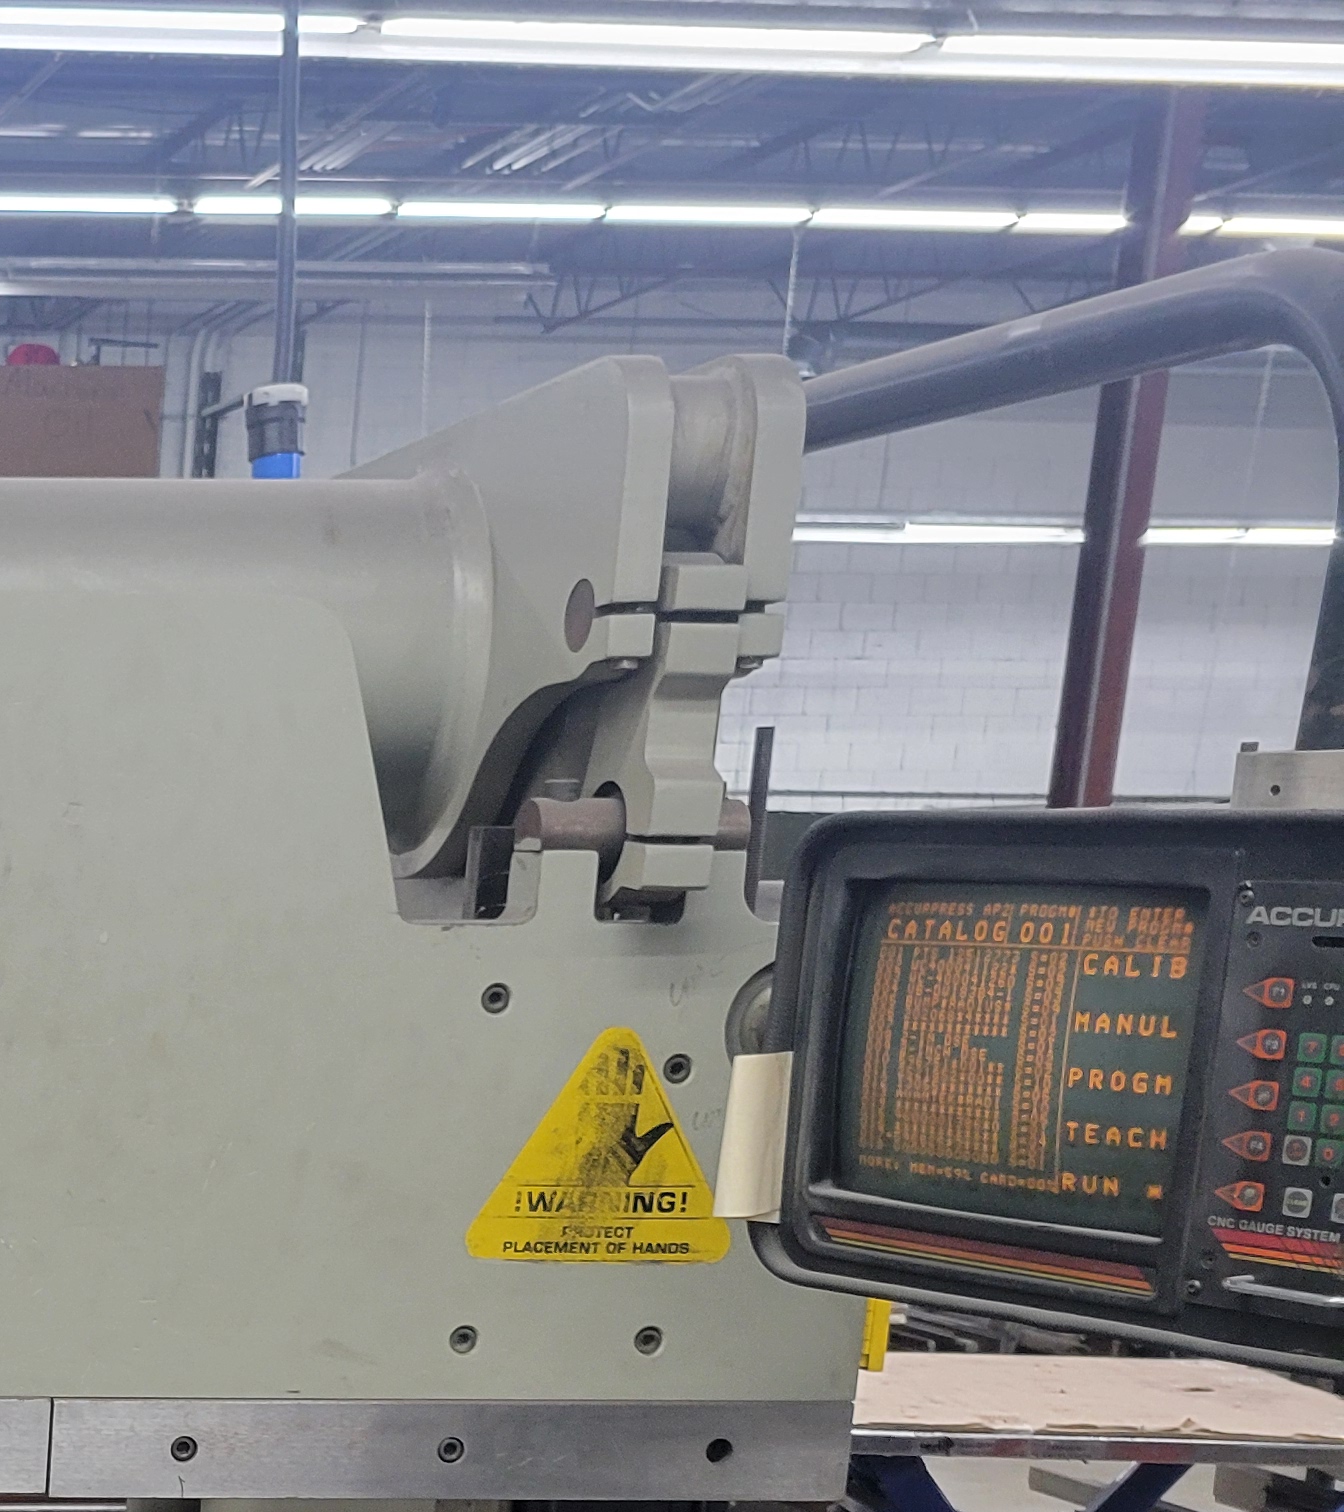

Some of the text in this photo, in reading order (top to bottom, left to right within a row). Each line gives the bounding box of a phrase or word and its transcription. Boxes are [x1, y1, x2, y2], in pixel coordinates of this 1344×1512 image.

[887, 918, 1070, 944] CATALOG 001
[1083, 953, 1187, 979] CALIB
[1074, 1011, 1177, 1038] MANUL
[1066, 1067, 1173, 1095] PROGM
[1066, 1121, 1168, 1150] TEACH
[1062, 1172, 1120, 1197] RUN
[1207, 1215, 1341, 1243] CNC GAUGE SYSTEM
[503, 1241, 690, 1254] PLACEMENT OF HANDS
